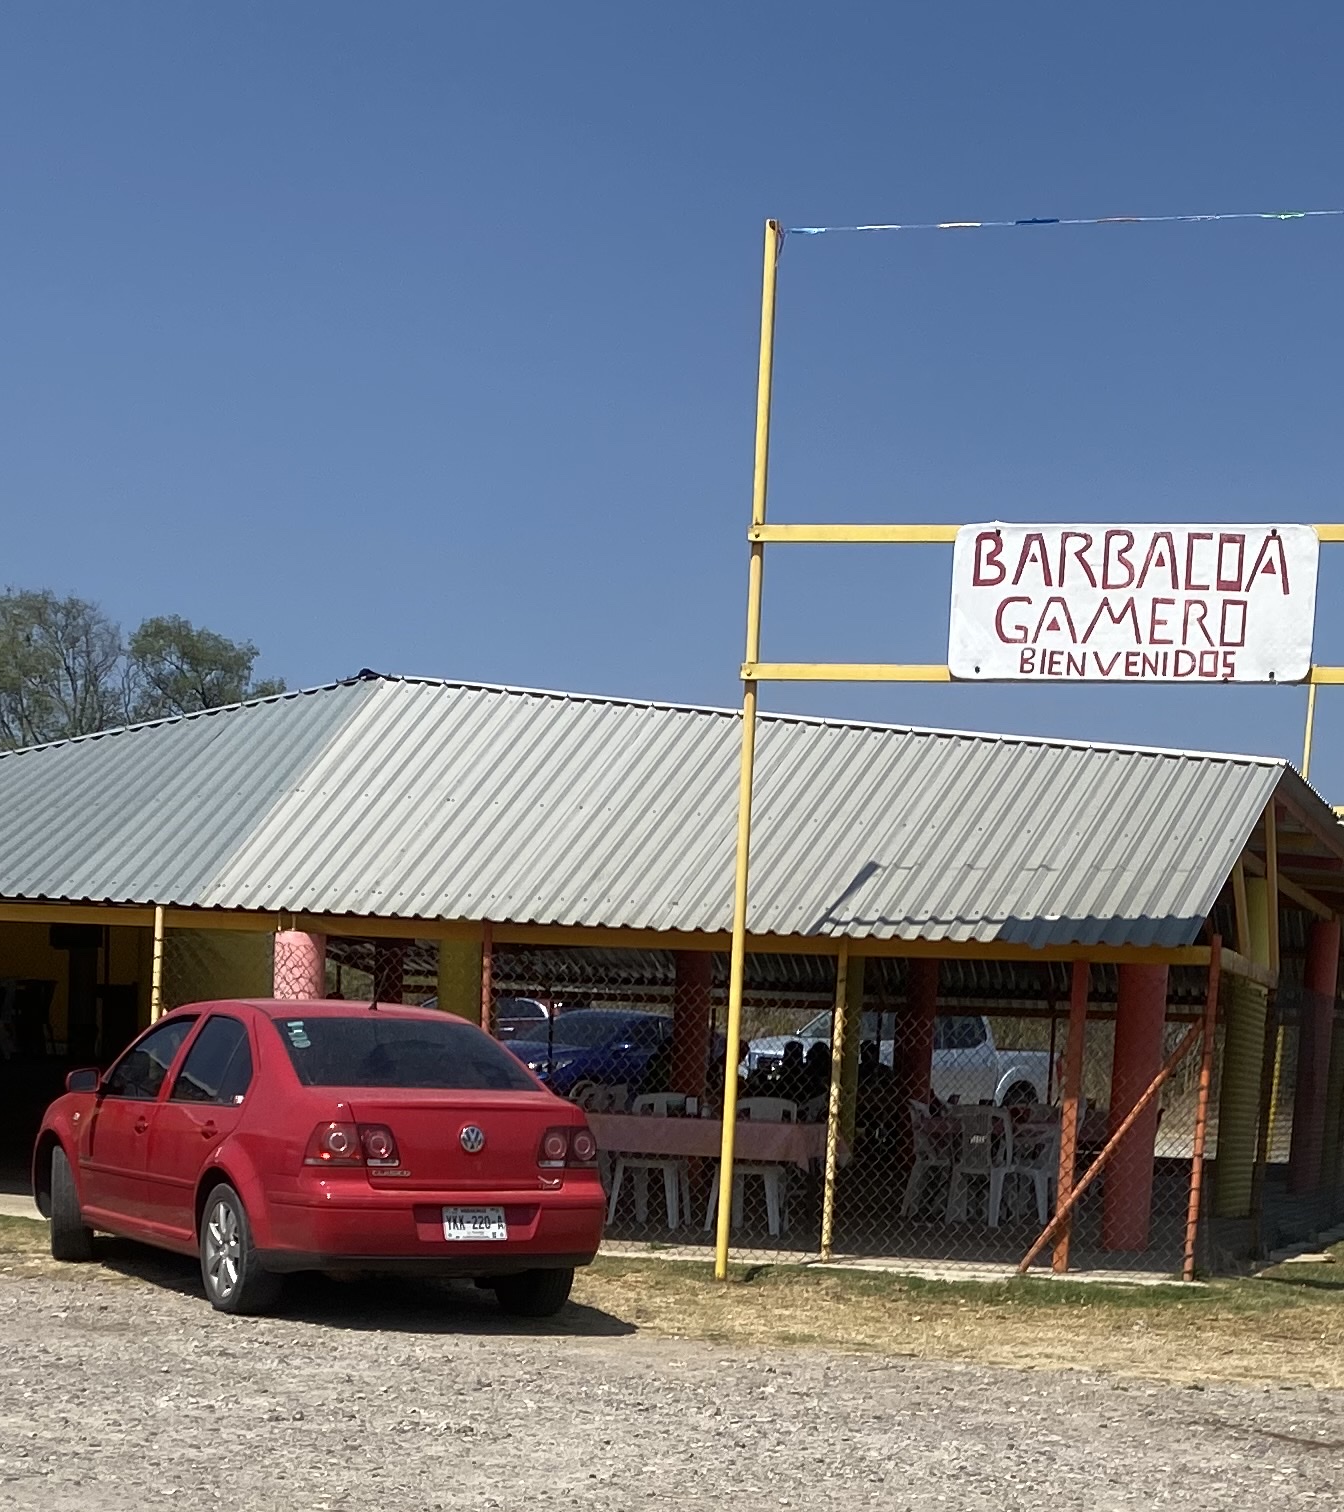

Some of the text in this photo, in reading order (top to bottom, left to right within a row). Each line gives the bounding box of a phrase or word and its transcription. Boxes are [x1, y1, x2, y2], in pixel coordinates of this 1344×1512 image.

[973, 529, 1290, 595] BARBACOA
[995, 596, 1248, 647] GAMERO
[1019, 648, 1237, 679] BIENVENIDOS
